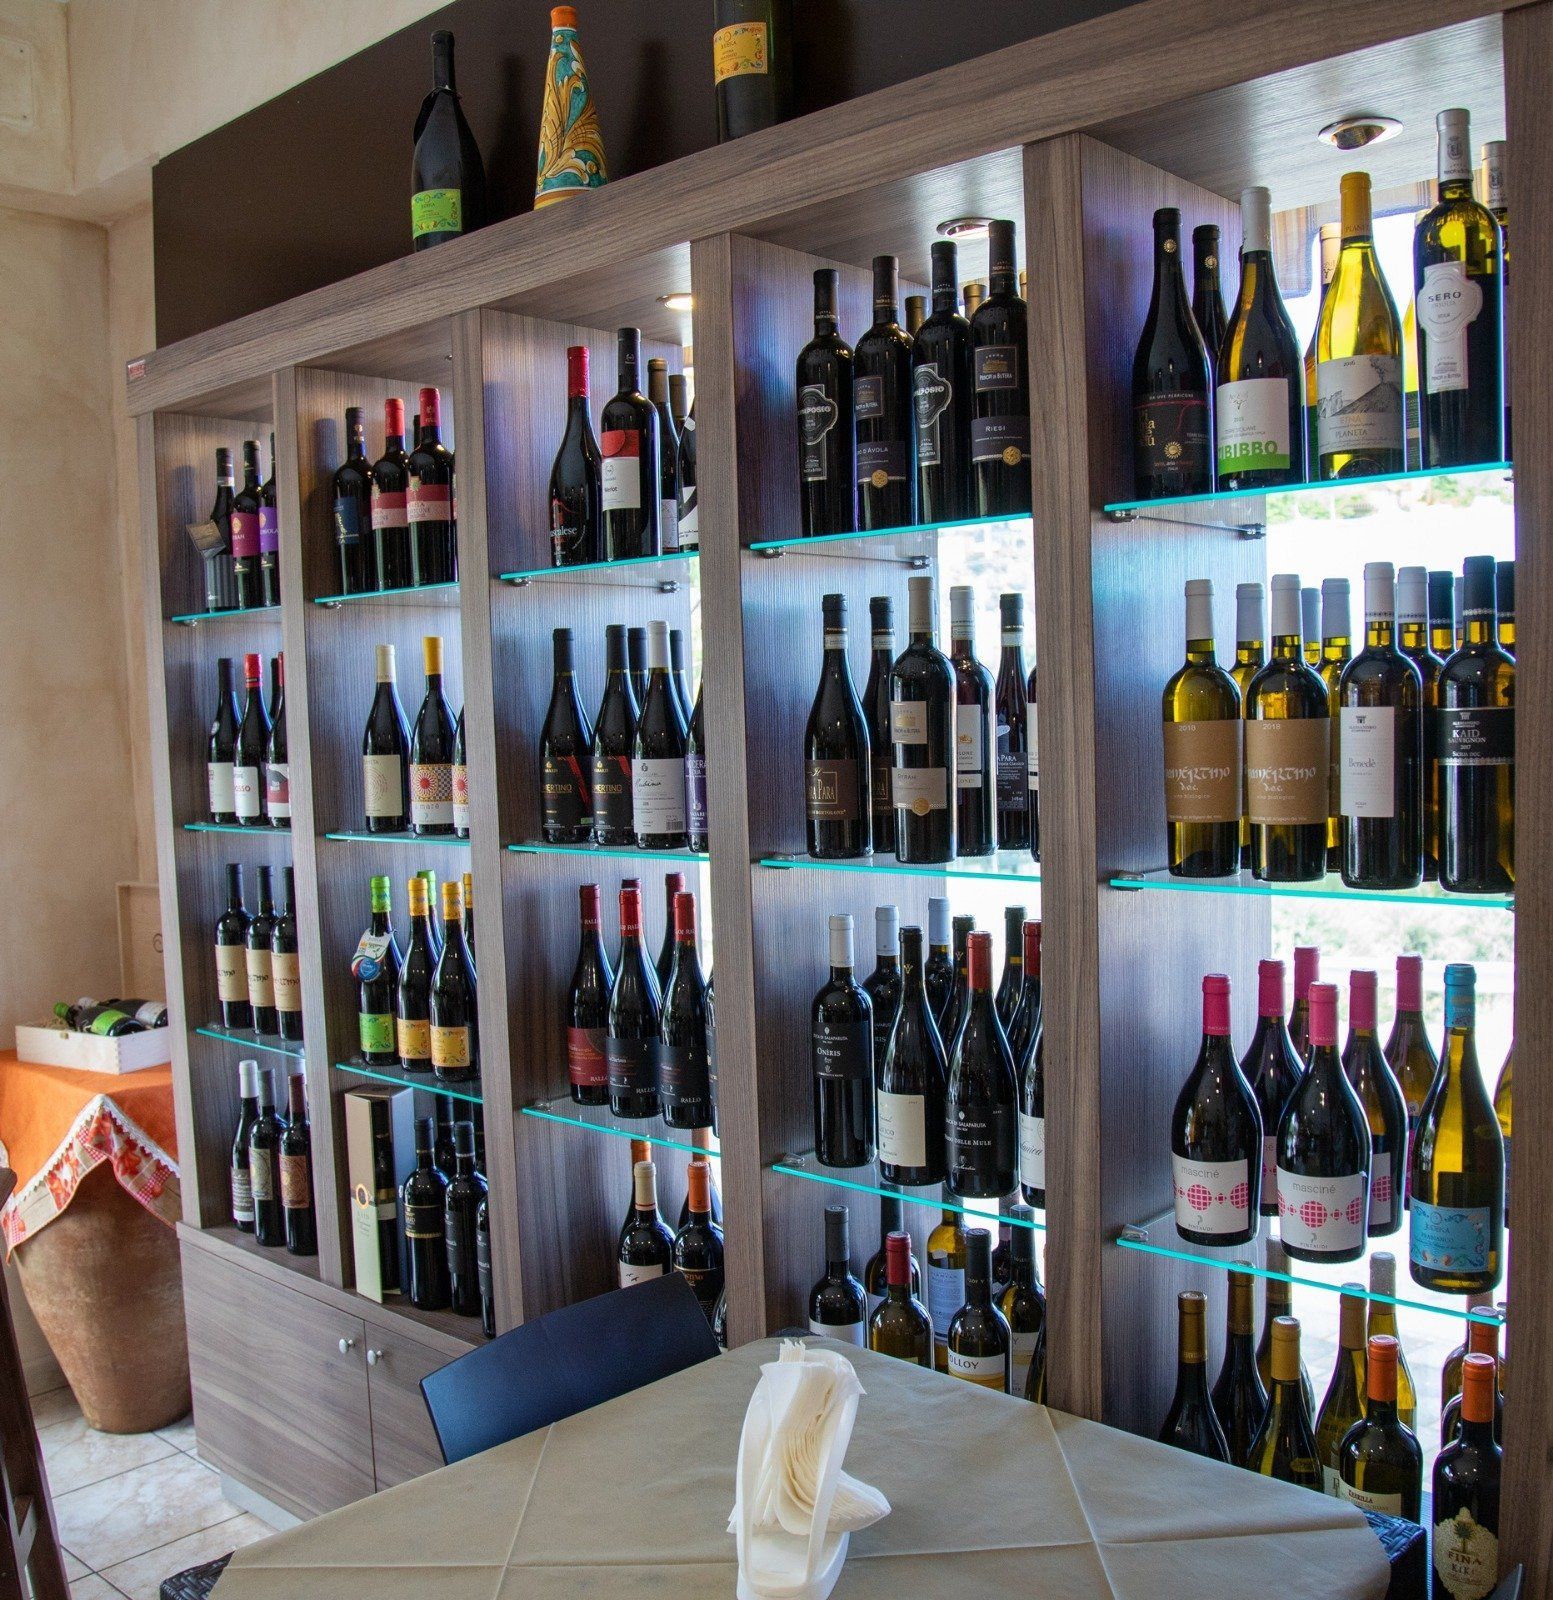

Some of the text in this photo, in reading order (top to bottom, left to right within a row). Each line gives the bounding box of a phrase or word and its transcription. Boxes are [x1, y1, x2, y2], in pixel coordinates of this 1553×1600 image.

[1335, 429, 1368, 438] PLANETA
[1452, 729, 1480, 738] KAID
[1180, 1165, 1220, 1179] masciné
[1291, 1181, 1337, 1195] masciné
[1448, 1549, 1482, 1566] FINA
